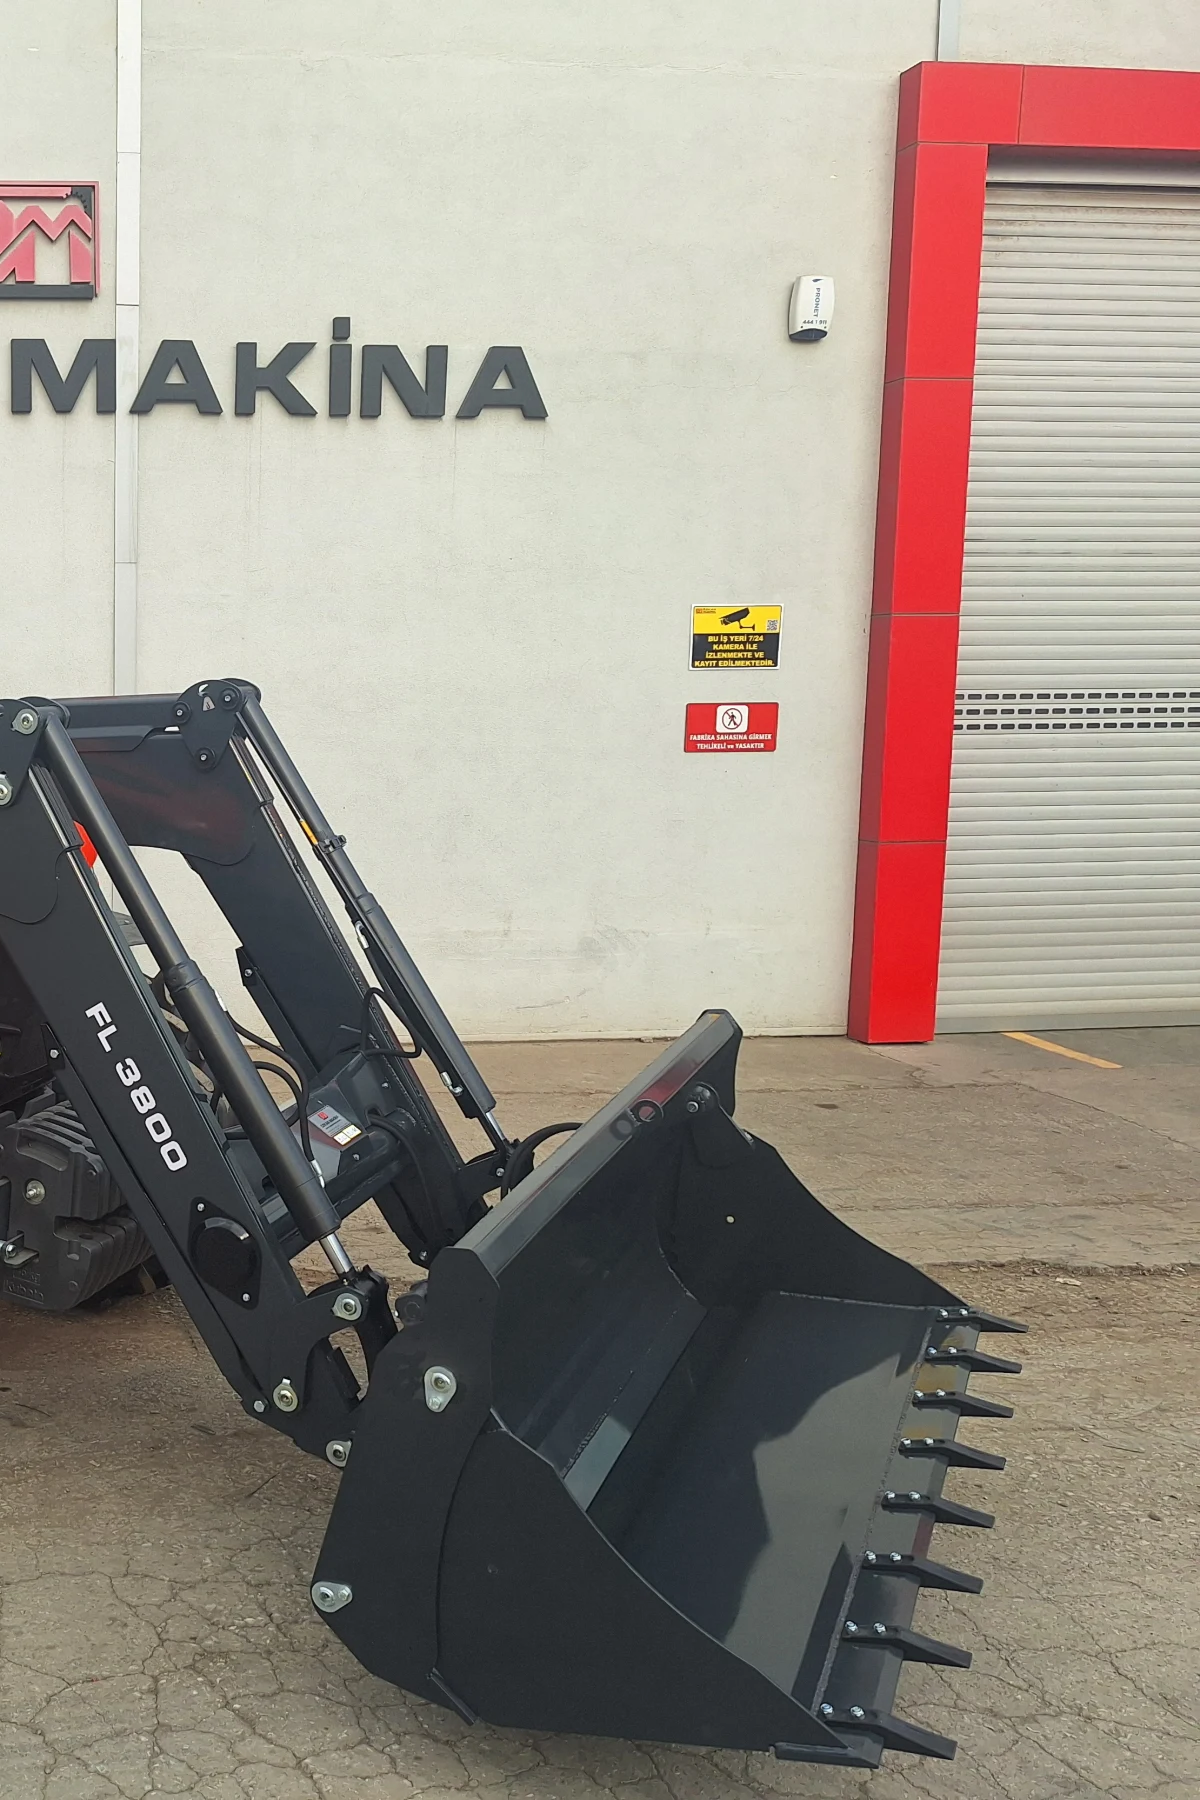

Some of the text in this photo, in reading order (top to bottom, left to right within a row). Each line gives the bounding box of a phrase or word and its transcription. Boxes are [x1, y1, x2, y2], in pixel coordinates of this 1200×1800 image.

[813, 287, 821, 317] PRONET
[11, 316, 548, 418] MAKİNA
[720, 634, 728, 643] İŞ
[730, 634, 747, 642] YERİ
[746, 642, 758, 650] İLE
[705, 651, 765, 659] İZLENMEKTE VE
[689, 732, 772, 741] FABRİKA SAHASINA GİRMEK
[85, 1002, 188, 1172] FL 3800
